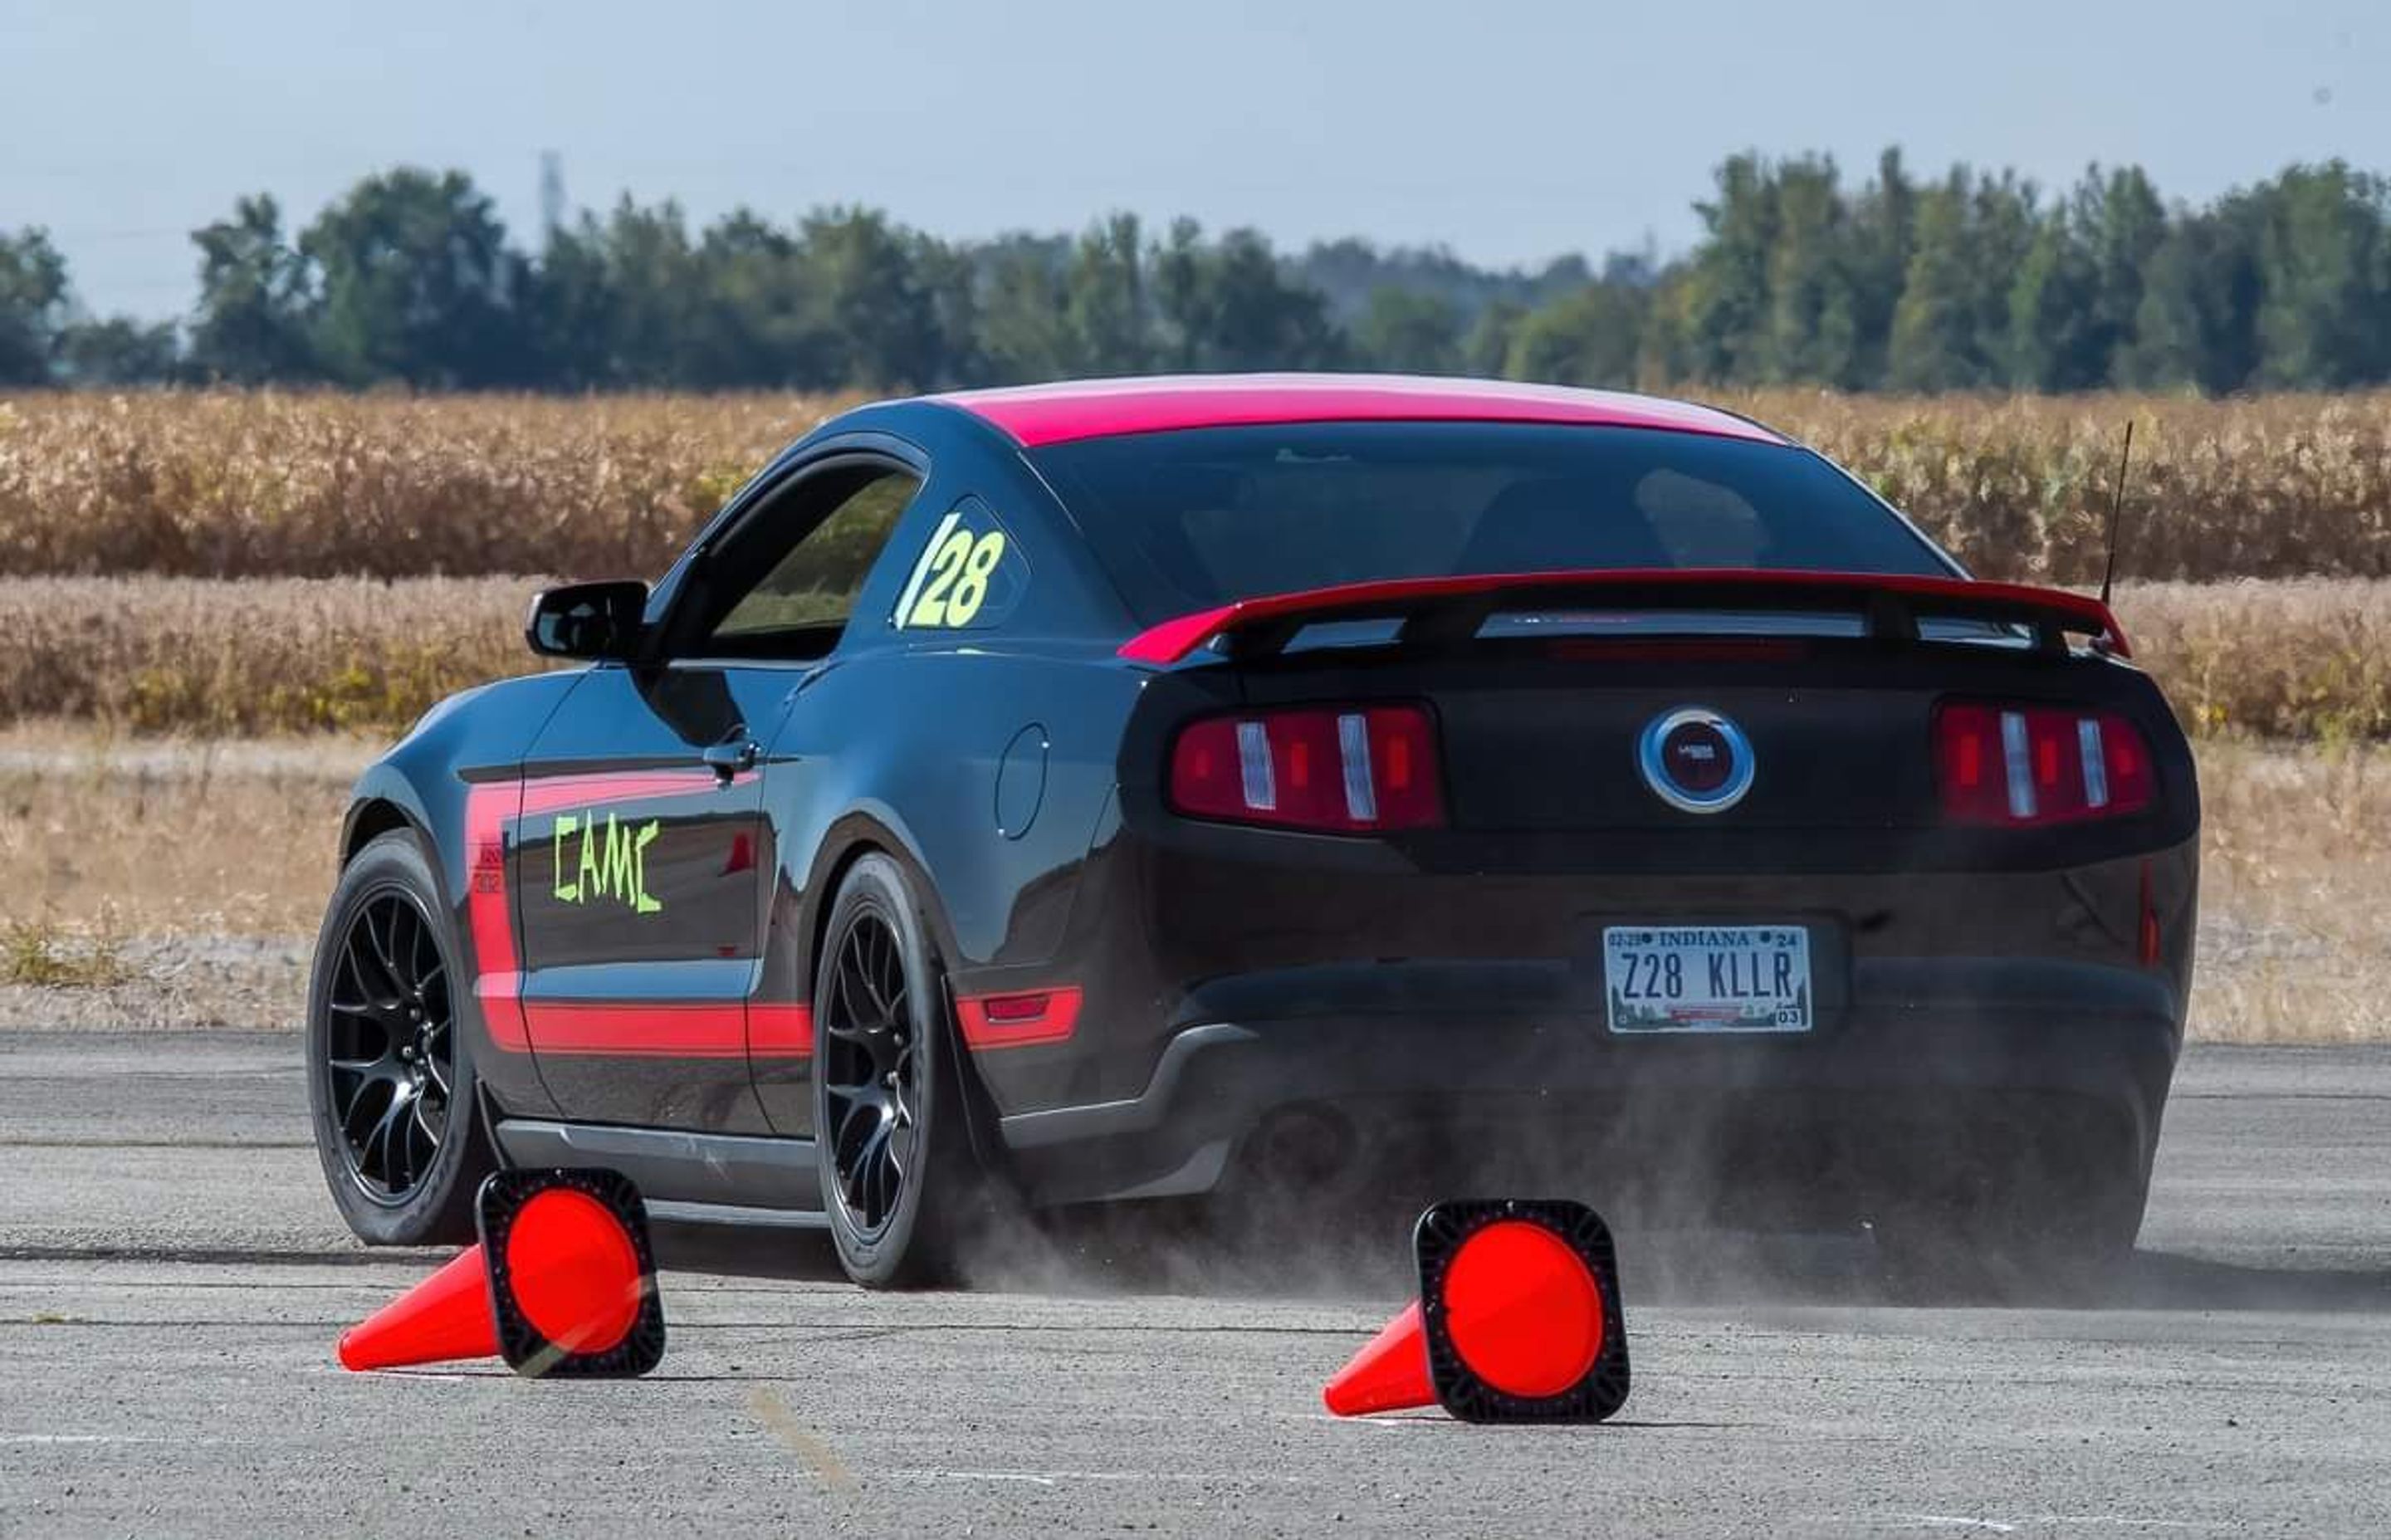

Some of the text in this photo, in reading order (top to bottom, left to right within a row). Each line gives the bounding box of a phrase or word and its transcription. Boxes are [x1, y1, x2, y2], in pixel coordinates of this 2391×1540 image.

[554, 809, 663, 914] CAMC
[1660, 931, 1750, 947] INDIANA
[1777, 933, 1797, 948] 24
[1621, 951, 1792, 999] Z28 KLLR
[1779, 1010, 1799, 1024] 03
